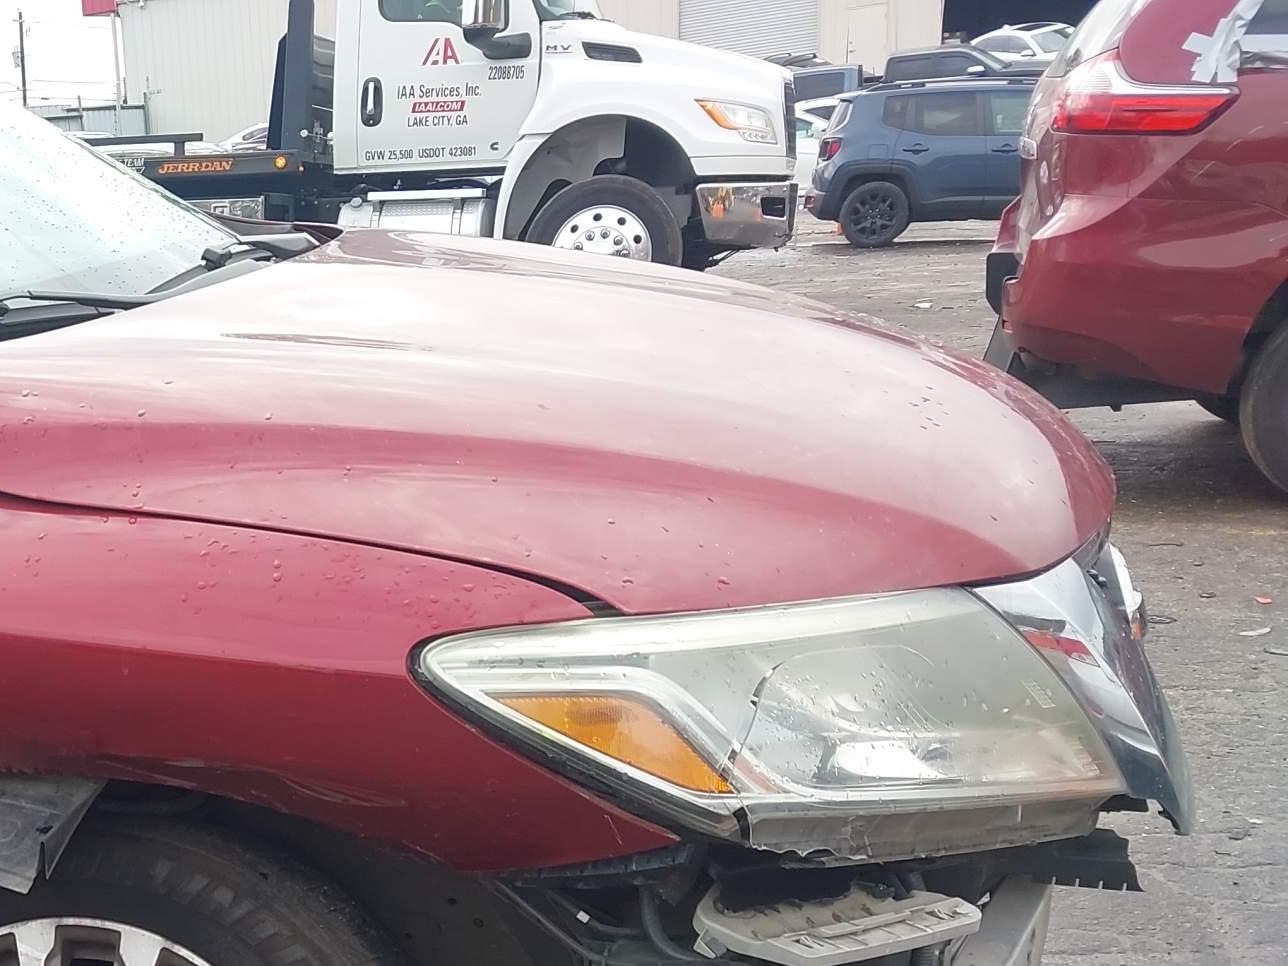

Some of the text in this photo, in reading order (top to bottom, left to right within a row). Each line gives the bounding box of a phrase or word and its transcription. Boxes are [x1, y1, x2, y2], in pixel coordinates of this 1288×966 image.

[487, 65, 526, 80] 22088705
[397, 81, 482, 100] IAA Services, Inc.
[407, 114, 468, 128] LAKE CITY, GA
[364, 146, 477, 161] GVW 25,500 USDOT 423081
